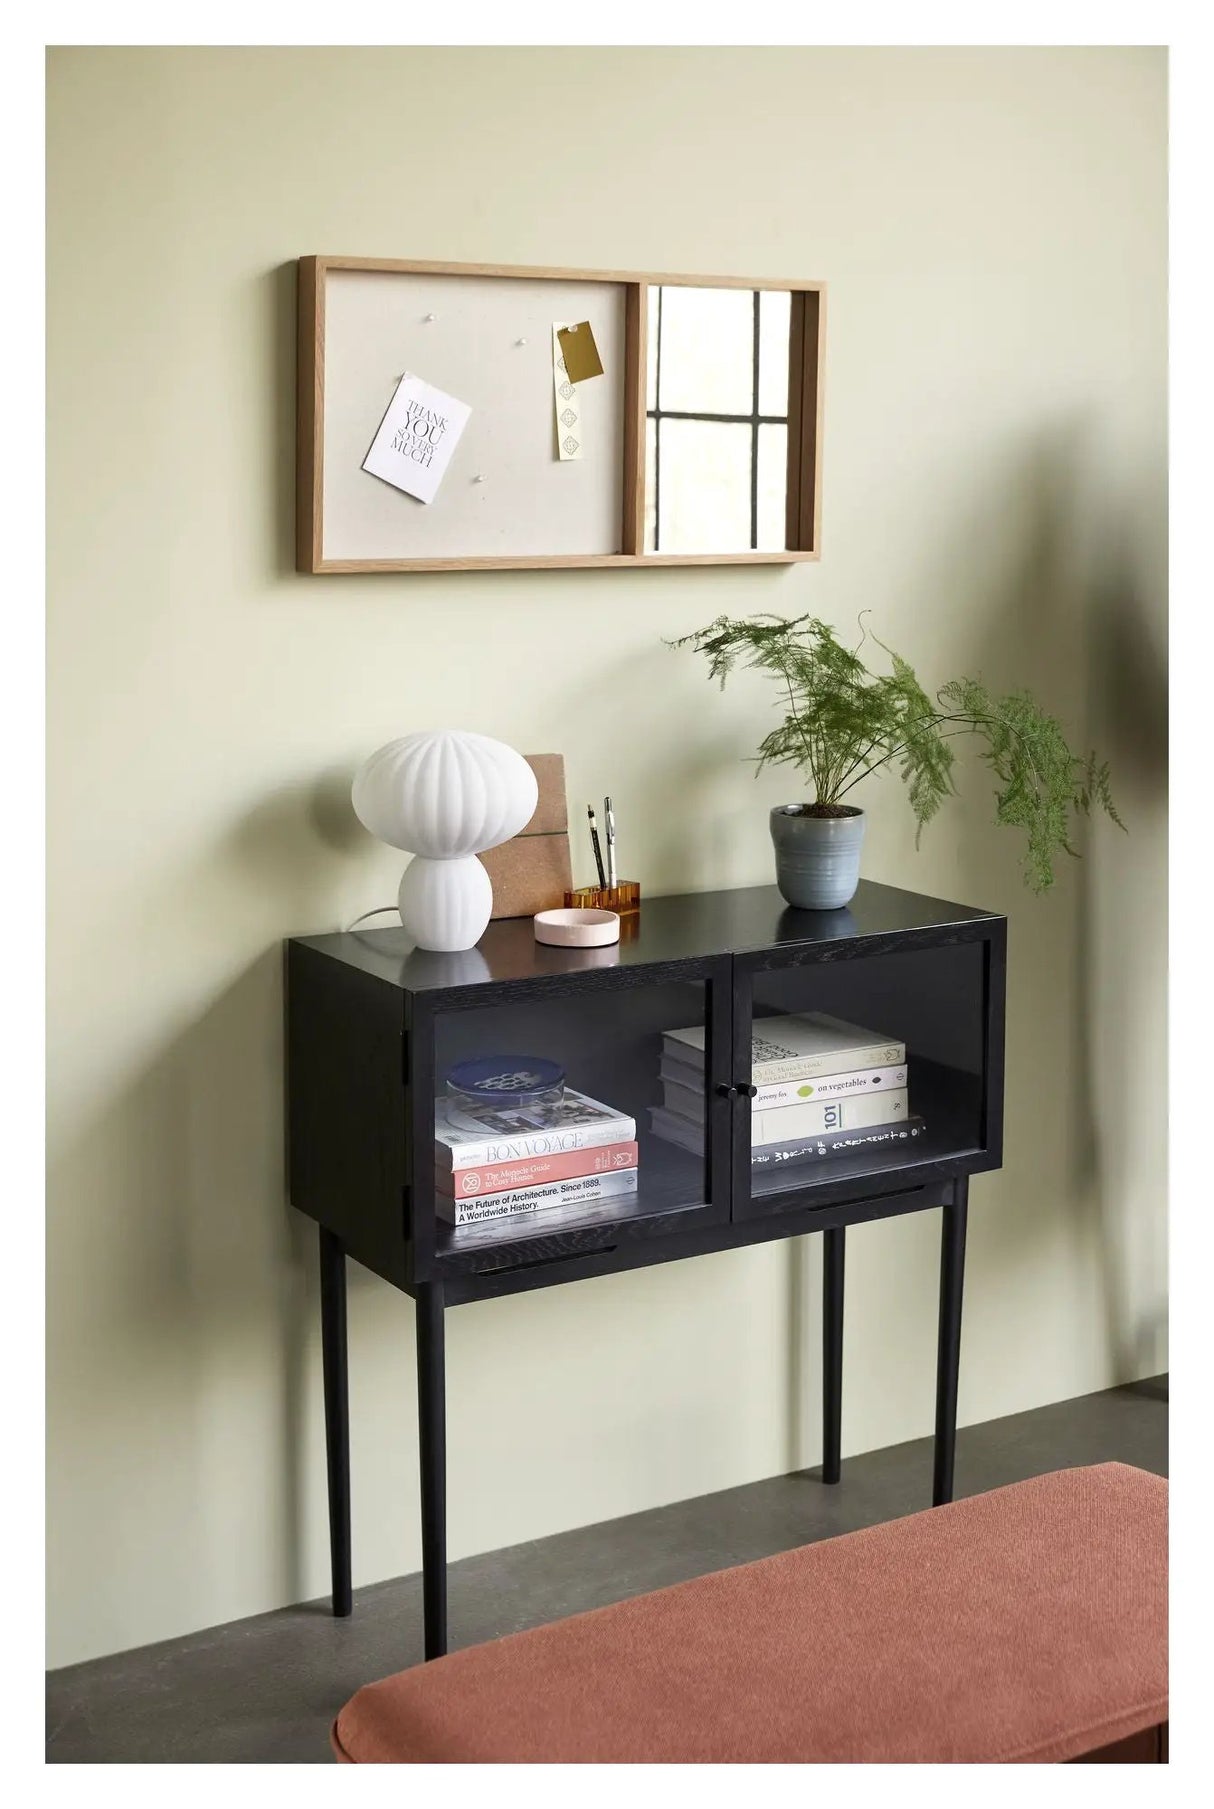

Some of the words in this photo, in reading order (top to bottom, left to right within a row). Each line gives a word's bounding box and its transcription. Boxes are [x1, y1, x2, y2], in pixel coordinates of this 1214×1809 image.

[405, 411, 444, 446] YOU
[408, 400, 448, 431] THANK
[390, 436, 433, 468] MUCH
[396, 429, 410, 441] SO
[411, 435, 438, 455] VERY
[758, 1092, 778, 1102] jeremy
[818, 1083, 828, 1092] on
[829, 1079, 867, 1091] vegetables
[824, 1104, 837, 1129] 101
[487, 1142, 521, 1162] BON
[524, 1132, 583, 1155] VOYAGE
[485, 1172, 498, 1181] The
[530, 1163, 551, 1172] Guide
[459, 1203, 473, 1212] The
[475, 1199, 500, 1209] Future
[502, 1195, 510, 1204] of
[512, 1188, 559, 1202] Architecture.
[560, 1182, 581, 1193] Since
[582, 1178, 601, 1188] 1889.
[458, 1214, 465, 1223] A
[466, 1206, 508, 1220] Worldwide
[510, 1201, 538, 1212] History.
